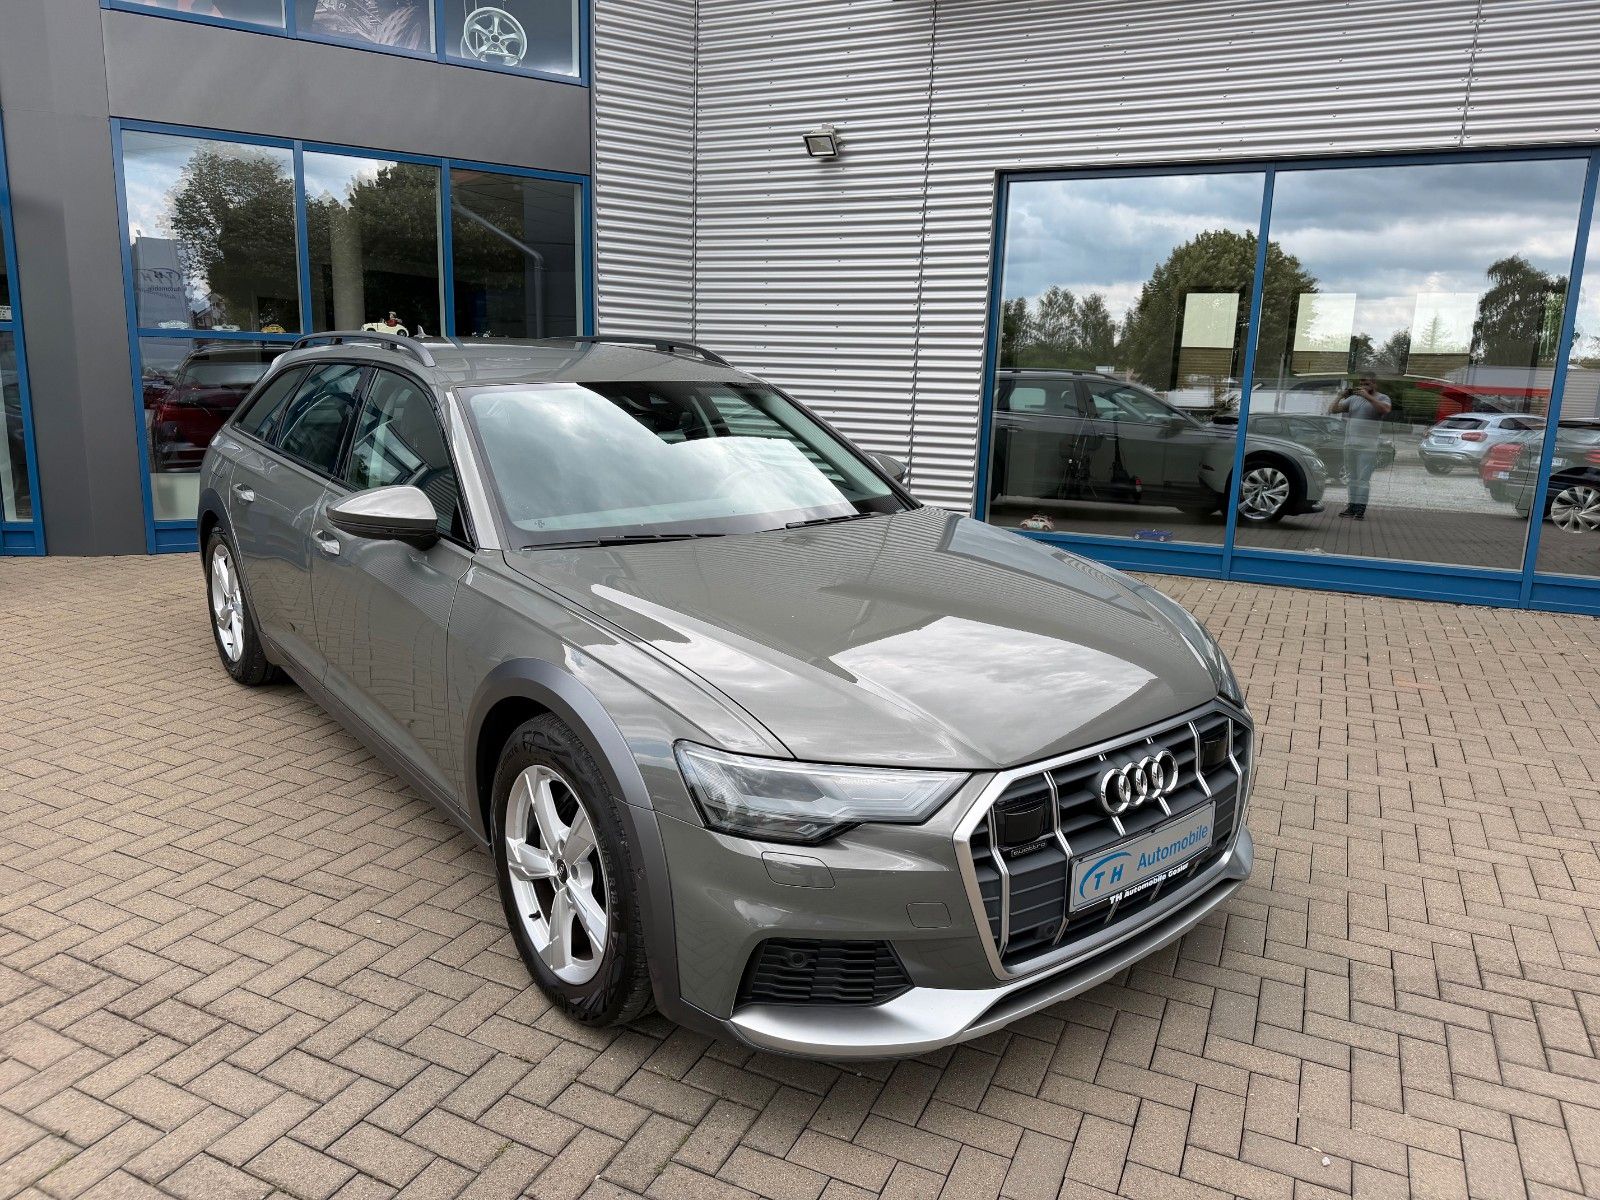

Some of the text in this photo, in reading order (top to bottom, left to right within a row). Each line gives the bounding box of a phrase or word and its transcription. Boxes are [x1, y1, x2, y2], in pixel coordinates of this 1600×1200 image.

[1011, 842, 1046, 857] quattro
[1094, 824, 1209, 891] T H Automobile
[1109, 891, 1123, 905] TH
[1124, 873, 1167, 899] Automobile
